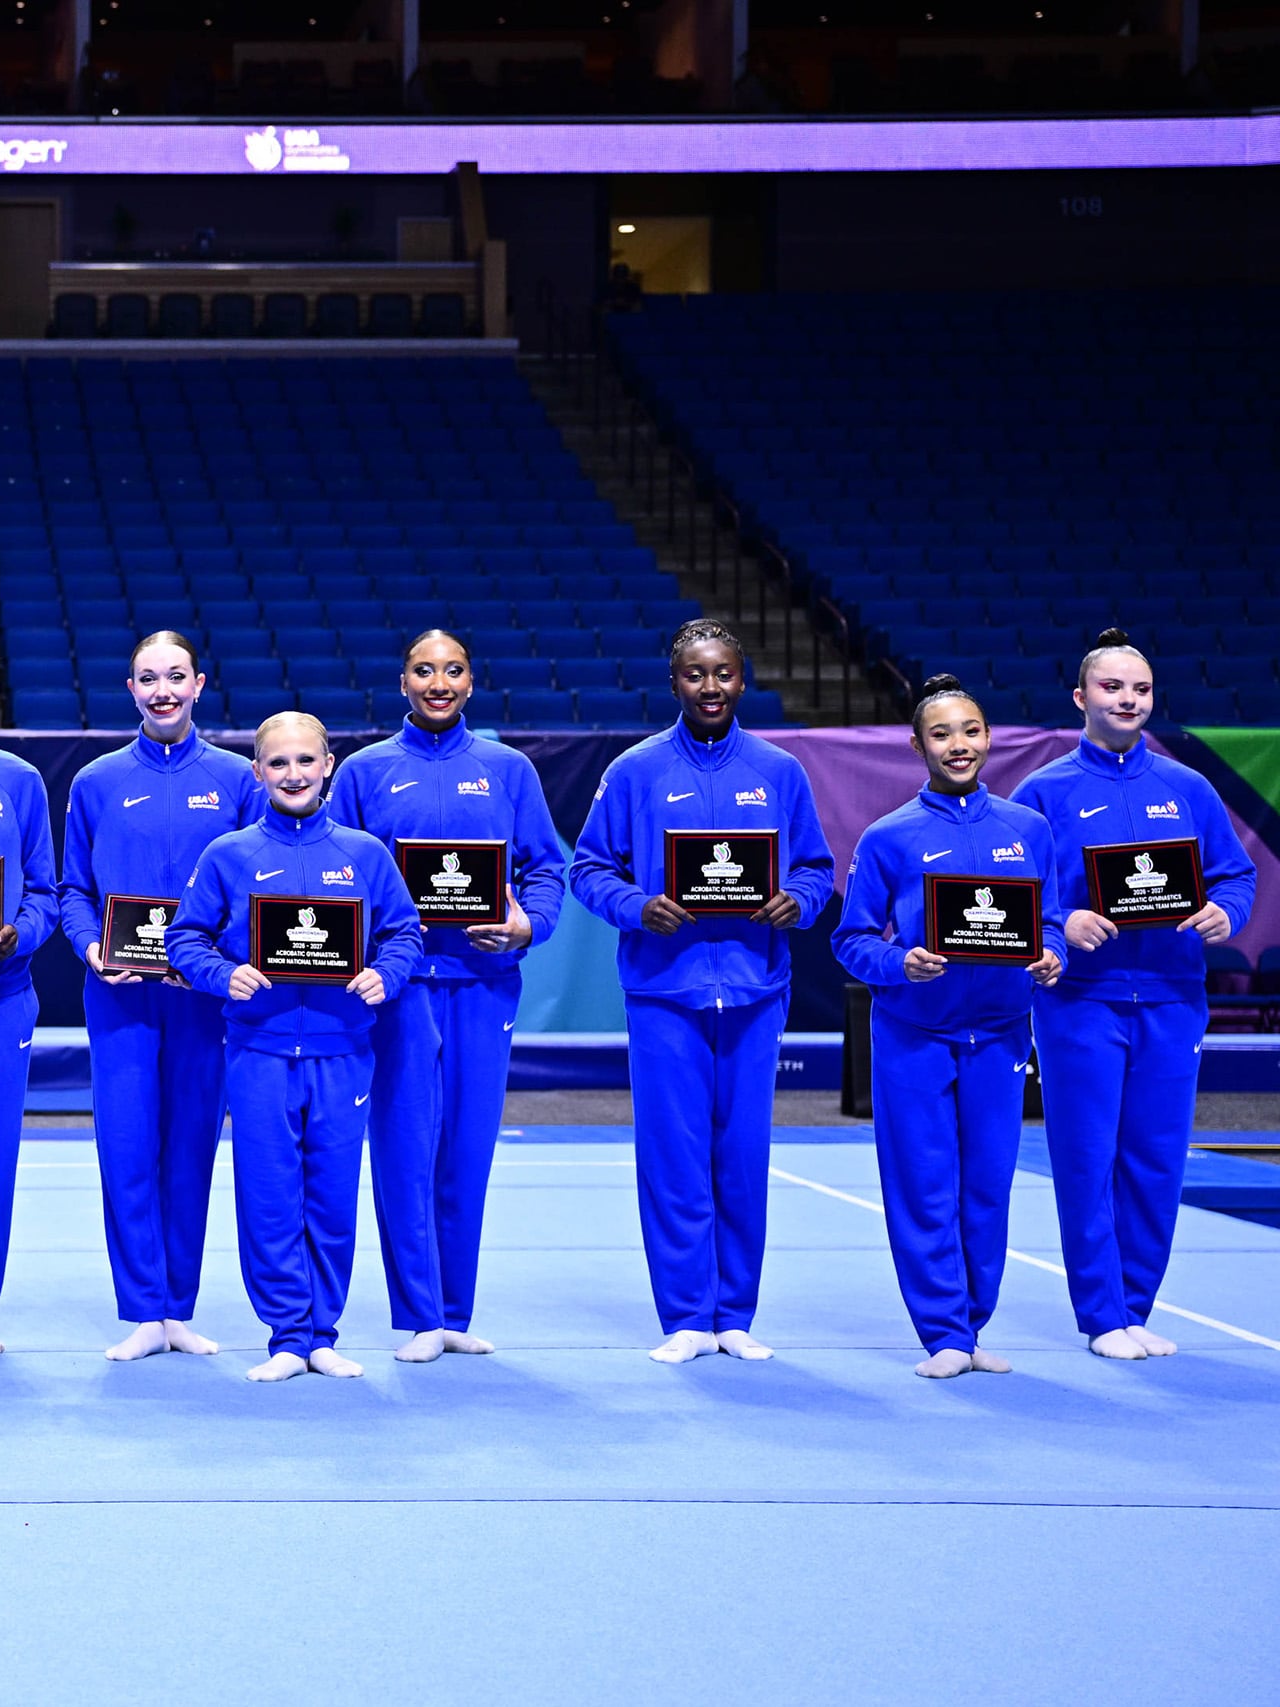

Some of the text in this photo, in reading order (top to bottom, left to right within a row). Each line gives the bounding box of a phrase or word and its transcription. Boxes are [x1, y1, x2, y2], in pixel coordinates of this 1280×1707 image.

[1059, 197, 1102, 216] 108
[458, 782, 478, 790] USA
[736, 792, 756, 800] USA
[992, 848, 1014, 856] USA
[322, 871, 343, 879] USA
[1148, 894, 1181, 902] GYMNASTICS
[133, 952, 157, 960] NATIONAL
